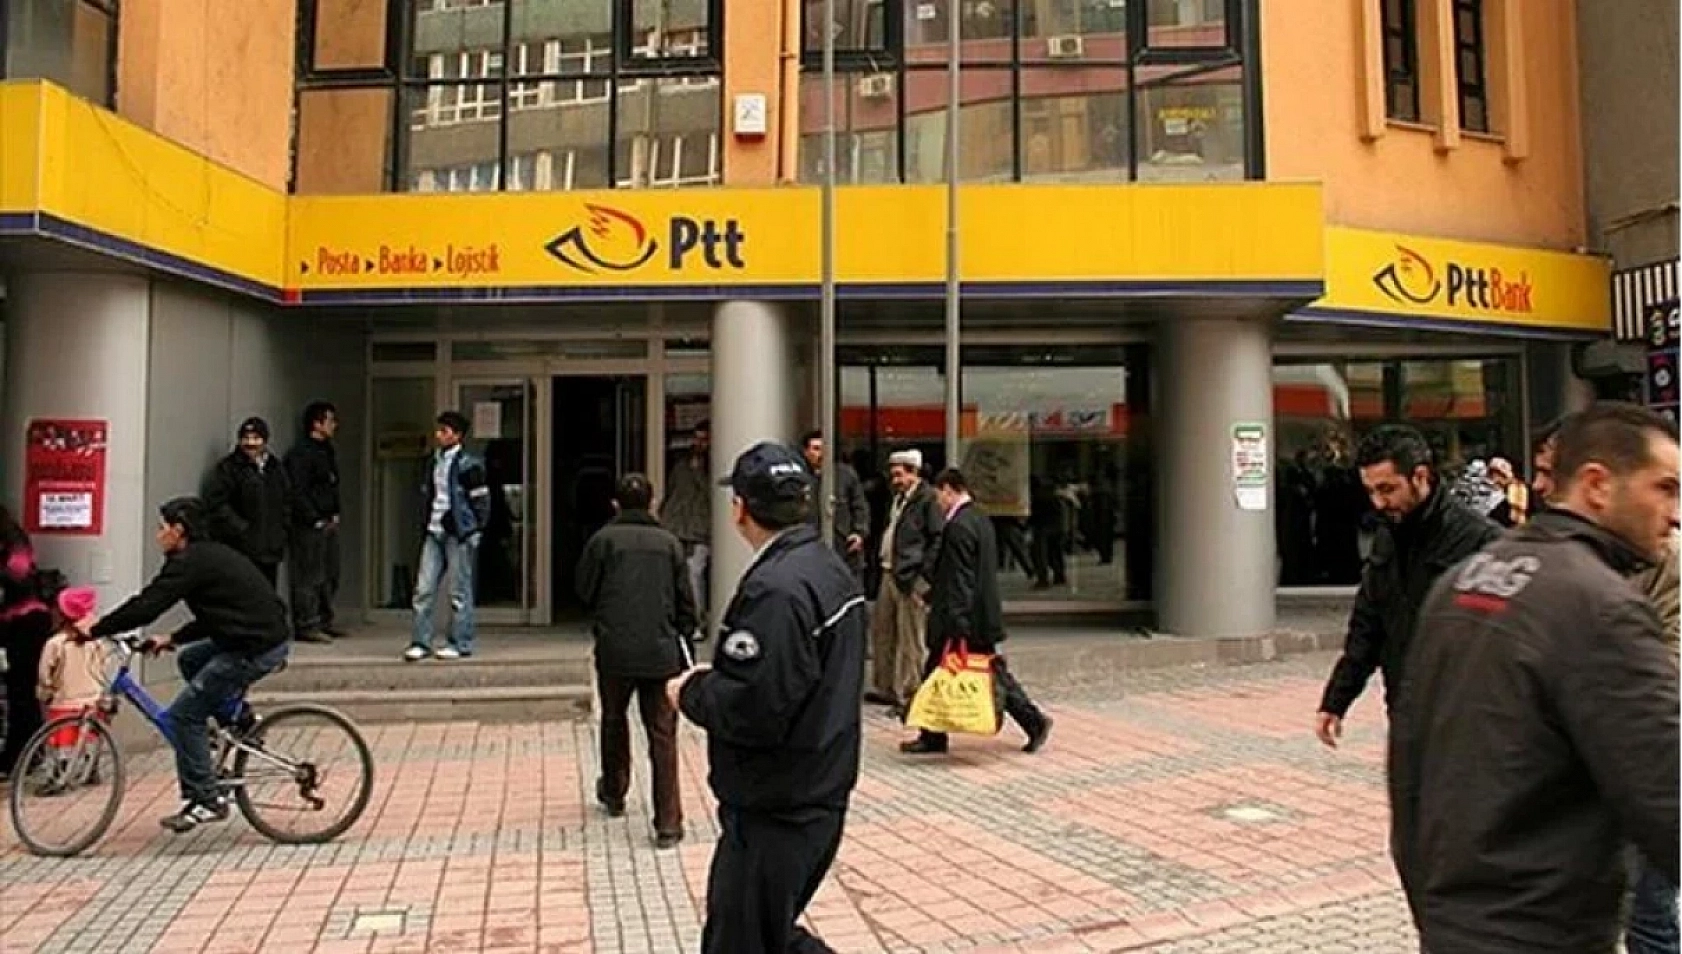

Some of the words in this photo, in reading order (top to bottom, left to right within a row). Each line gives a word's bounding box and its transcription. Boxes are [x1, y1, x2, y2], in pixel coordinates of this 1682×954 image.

[318, 245, 360, 274] Posta
[380, 245, 427, 274] Banka
[447, 244, 499, 277] Lojistik
[669, 216, 745, 269] Ptt
